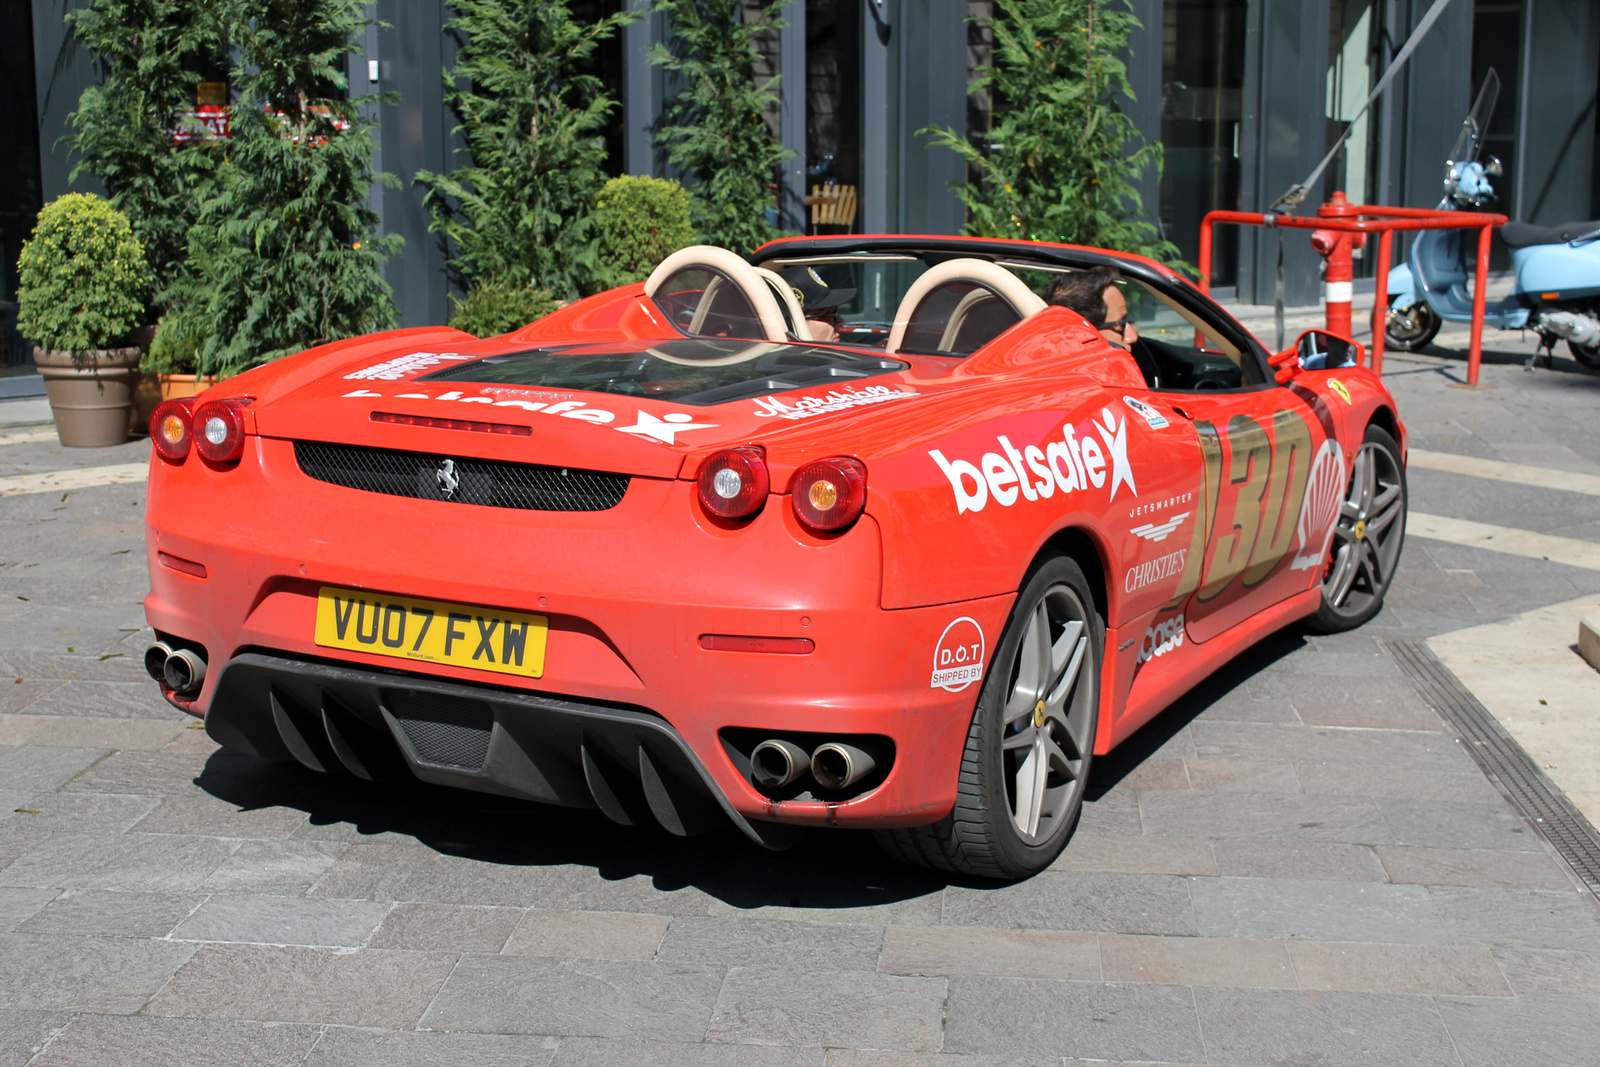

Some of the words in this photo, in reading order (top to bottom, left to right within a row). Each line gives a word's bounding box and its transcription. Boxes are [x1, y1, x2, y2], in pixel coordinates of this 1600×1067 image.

[753, 385, 901, 418] Marshall
[928, 422, 1107, 515] betsafe
[1129, 493, 1193, 518] JETSMARTER
[1125, 548, 1187, 594] CHRISTIE'S
[334, 596, 435, 652] VU07
[444, 612, 529, 667] FXW
[933, 669, 969, 684] SHIPPED
[971, 667, 982, 678] BY
